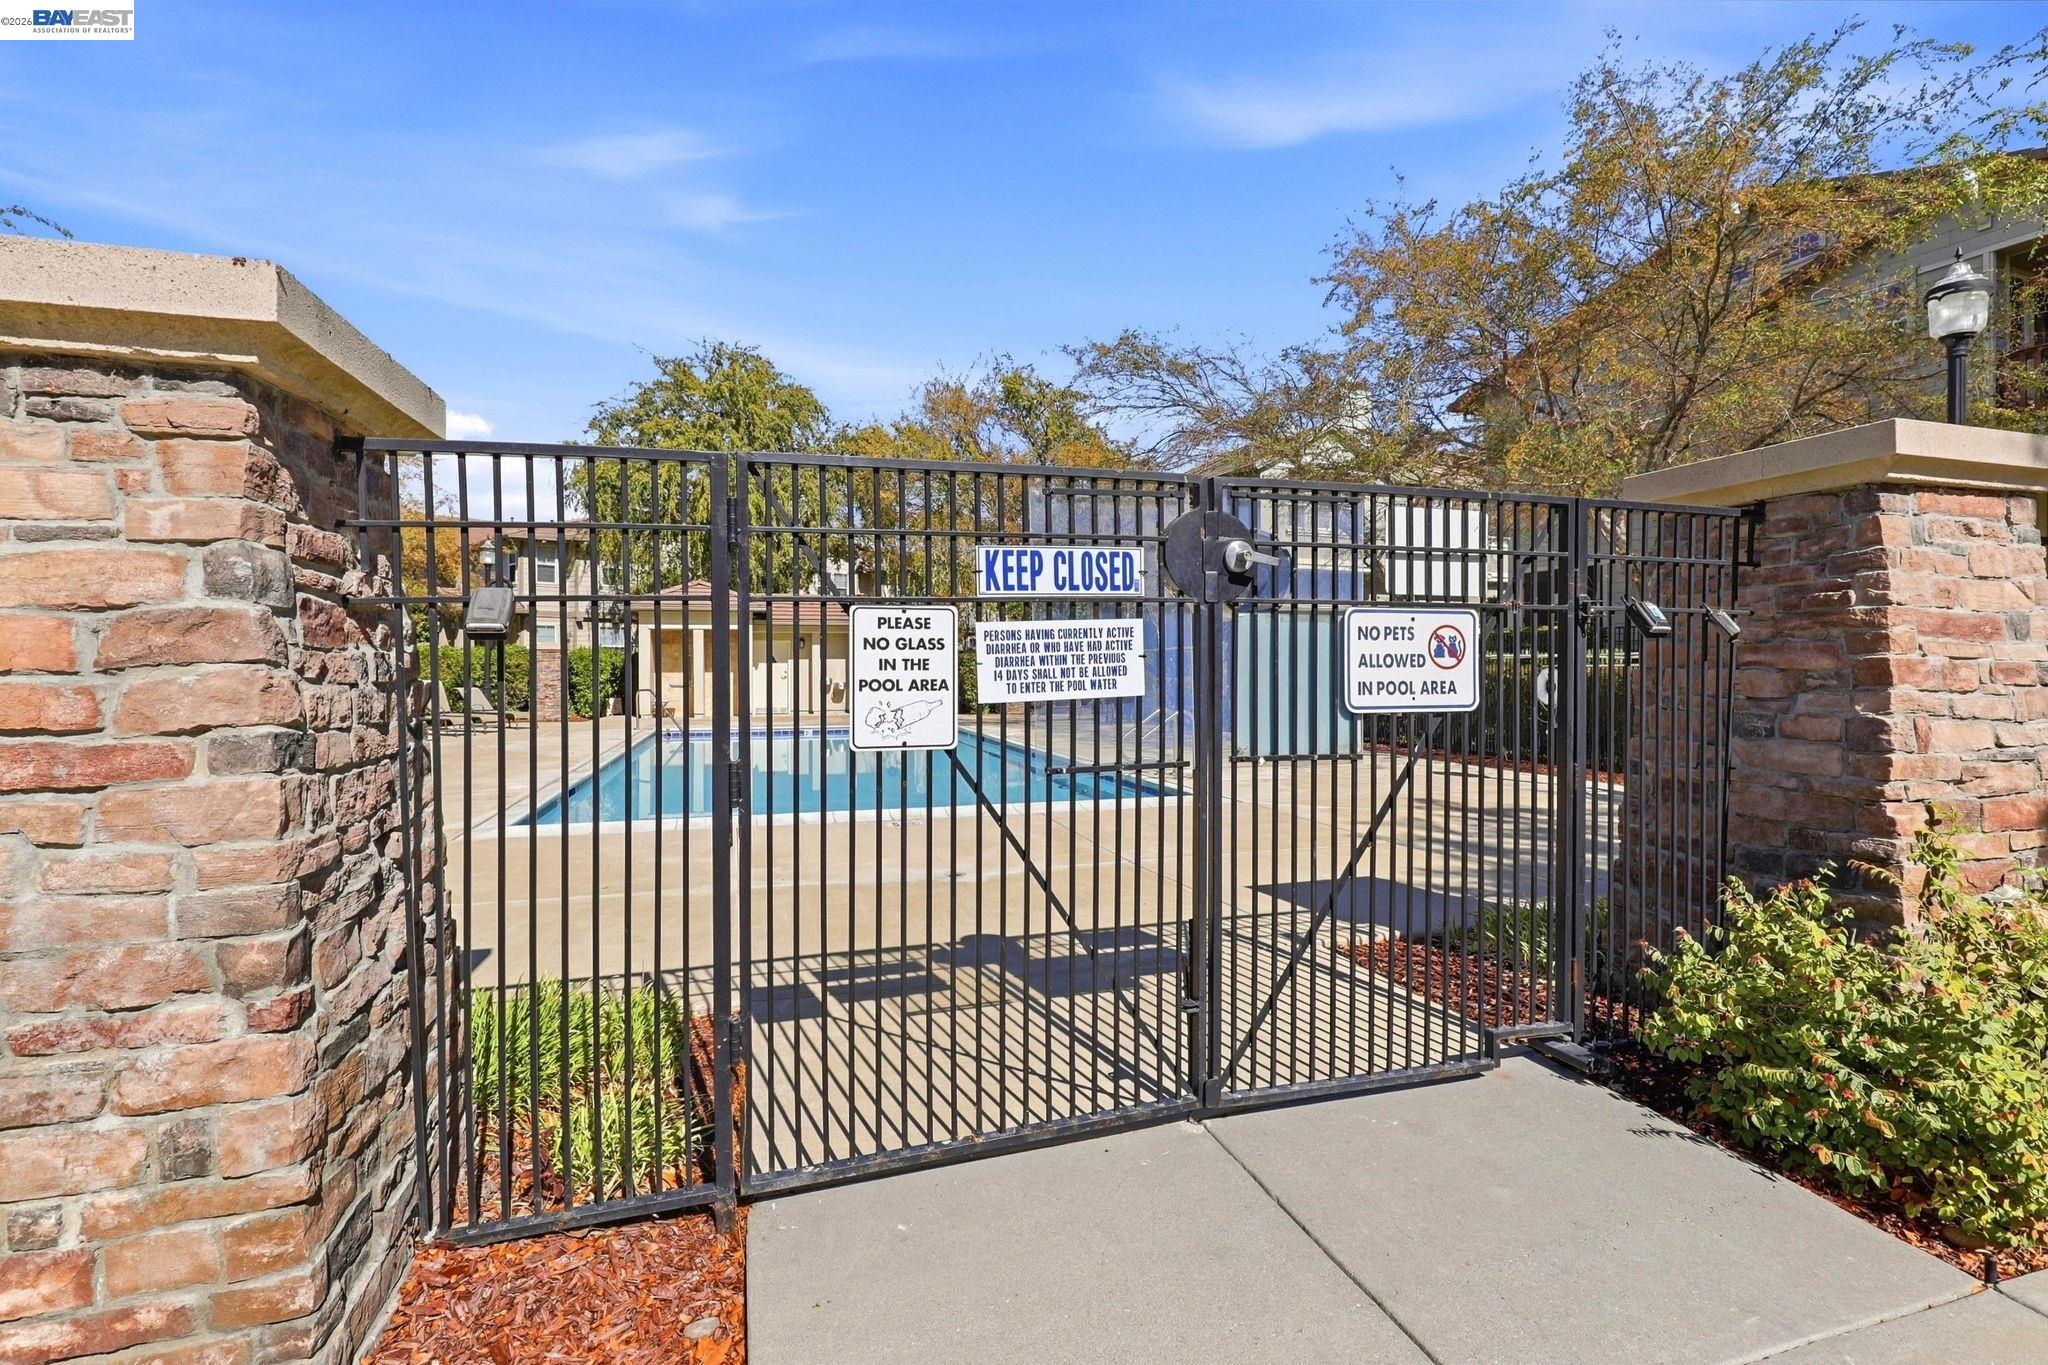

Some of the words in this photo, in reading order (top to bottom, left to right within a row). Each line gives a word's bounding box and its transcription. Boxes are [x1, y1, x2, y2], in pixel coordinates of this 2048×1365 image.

[985, 550, 1044, 592] KEEP
[1054, 550, 1134, 592] CLOSED
[878, 616, 931, 630] PLEASE
[984, 630, 1022, 641] PERSONS
[1025, 629, 1055, 640] HAVING
[1058, 628, 1103, 639] CURRENTLY
[1107, 627, 1134, 638] ACTIVE
[1358, 626, 1380, 640] NO
[1384, 626, 1414, 641] PETS
[863, 638, 890, 650] NO
[896, 638, 946, 650] GLASS
[986, 643, 1027, 654] DIARRHEA
[1030, 642, 1040, 653] OR
[1044, 642, 1060, 652] WHO
[1064, 641, 1084, 652] HAVE
[1087, 640, 1102, 651] HAD
[1105, 640, 1133, 651] ACTIVE
[878, 658, 896, 671] IN
[902, 658, 930, 671] THE
[995, 656, 1035, 668] DIARRHEA
[1039, 654, 1067, 666] WITHIN
[1071, 654, 1085, 665] THE
[1089, 653, 1126, 664] PREVIOUS
[1358, 654, 1426, 668] ALLOWED
[994, 670, 1003, 681] 14
[1006, 669, 1028, 681] DAYS
[1032, 668, 1057, 679] SHALL
[1061, 667, 1075, 678] NOT
[1079, 667, 1089, 678] BE
[1093, 665, 1127, 677] ALLOWED
[858, 679, 903, 692] POOL
[908, 679, 950, 692] AREA
[1006, 683, 1017, 694] TO
[1020, 682, 1046, 693] ENTER
[1050, 681, 1064, 692] THE
[1068, 680, 1087, 691] POOL
[1090, 679, 1117, 690] WATER
[1358, 681, 1372, 695] IN
[1377, 681, 1415, 695] POOL
[1420, 681, 1457, 694] AREA
